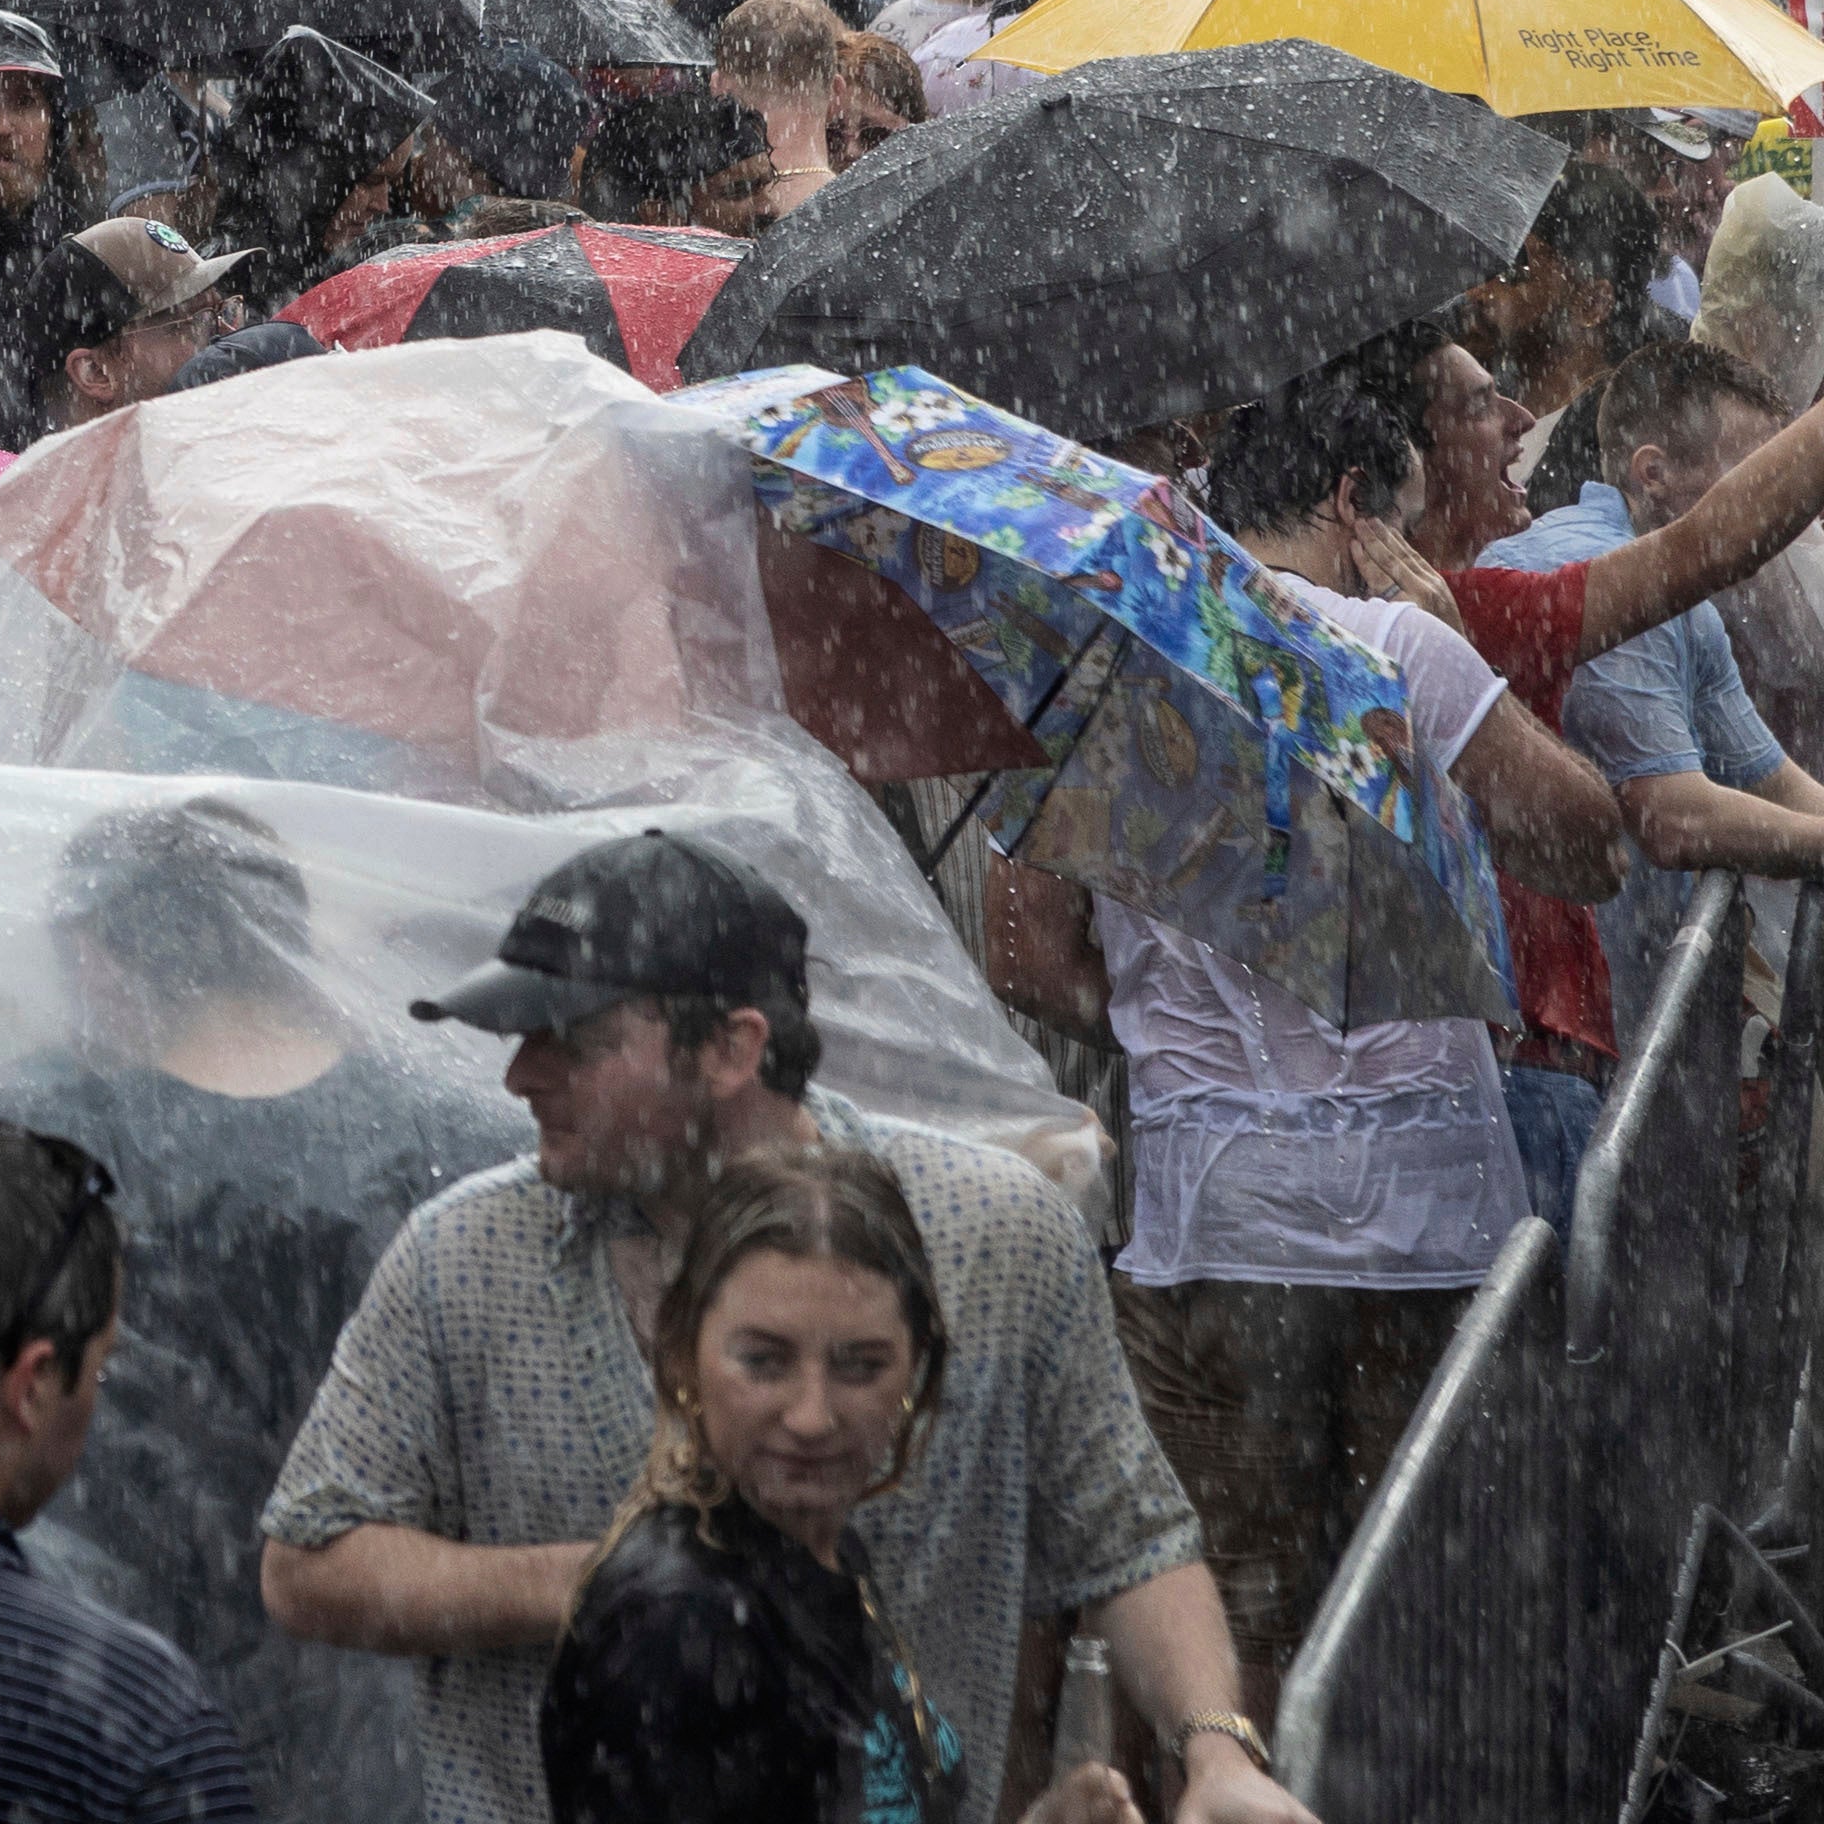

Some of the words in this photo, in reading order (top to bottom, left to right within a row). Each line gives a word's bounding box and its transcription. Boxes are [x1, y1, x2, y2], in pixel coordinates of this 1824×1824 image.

[1518, 28, 1583, 54] Right
[1583, 28, 1660, 49] Place,
[1564, 47, 1632, 73] Right
[1630, 47, 1702, 68] Time
